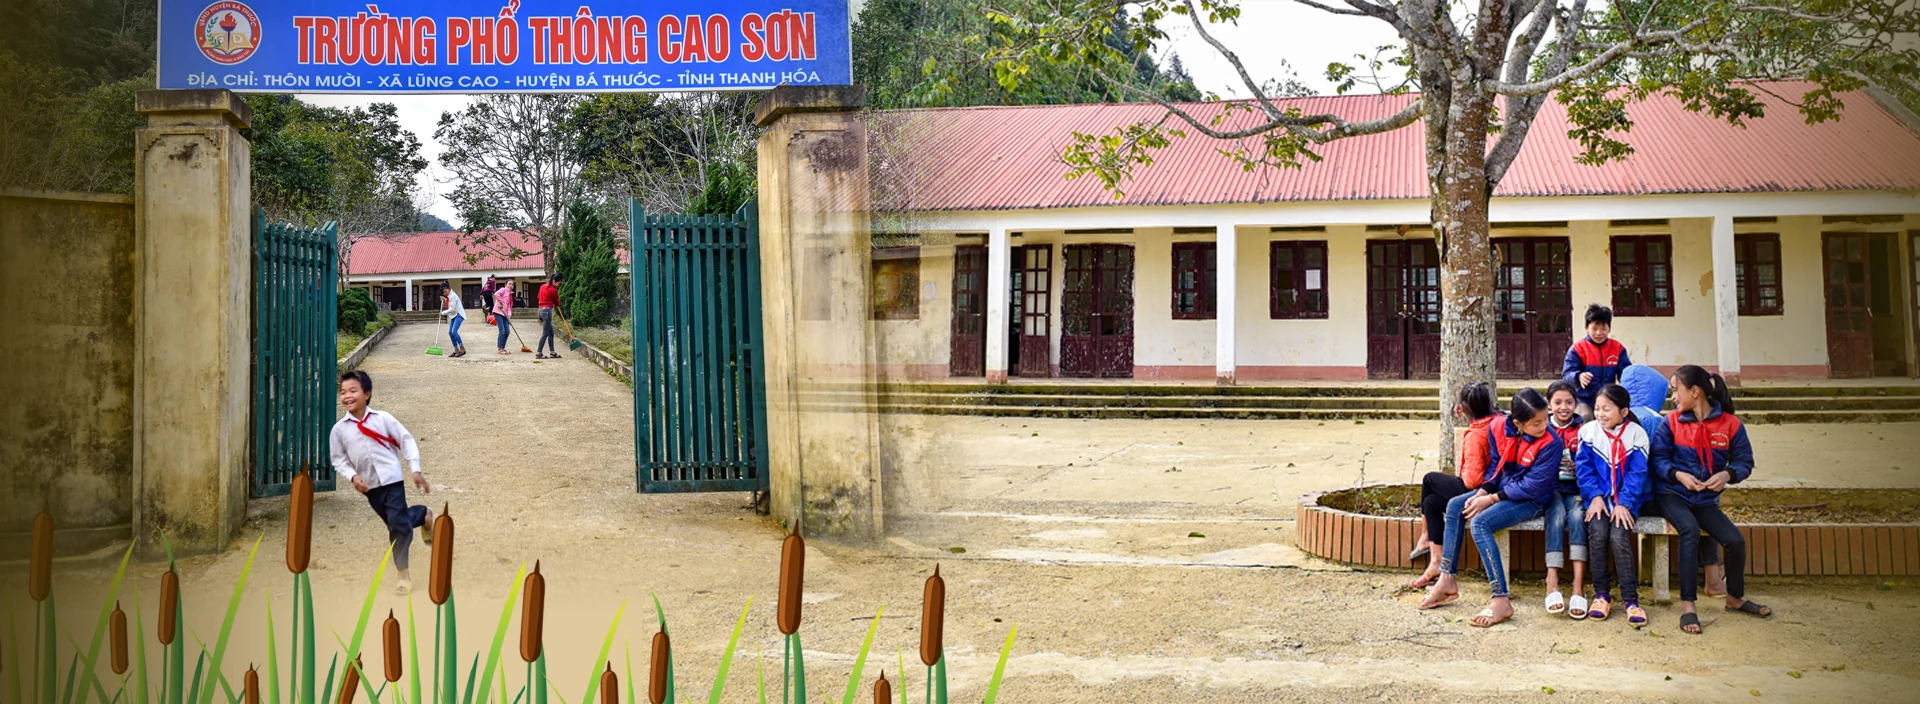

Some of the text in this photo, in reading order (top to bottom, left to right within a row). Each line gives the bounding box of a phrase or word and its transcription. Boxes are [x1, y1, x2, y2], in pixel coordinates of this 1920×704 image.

[293, 0, 816, 66] TRƯỜNG PHỔ THÔNG CAO SƠN
[187, 72, 218, 89] ĐỊA
[223, 70, 258, 87] CHỈ:
[263, 72, 309, 87] THÔN
[315, 72, 361, 87] MƯỜI
[378, 73, 402, 87] XÃ
[408, 73, 453, 88] LŨNG
[459, 75, 498, 87] CAO
[516, 73, 570, 88] HUYỆN
[576, 71, 598, 87] BÁ
[603, 71, 661, 87] THƯỚC
[677, 69, 714, 85] TỈNH
[719, 71, 775, 85] THANH
[781, 68, 821, 84] HÓA
